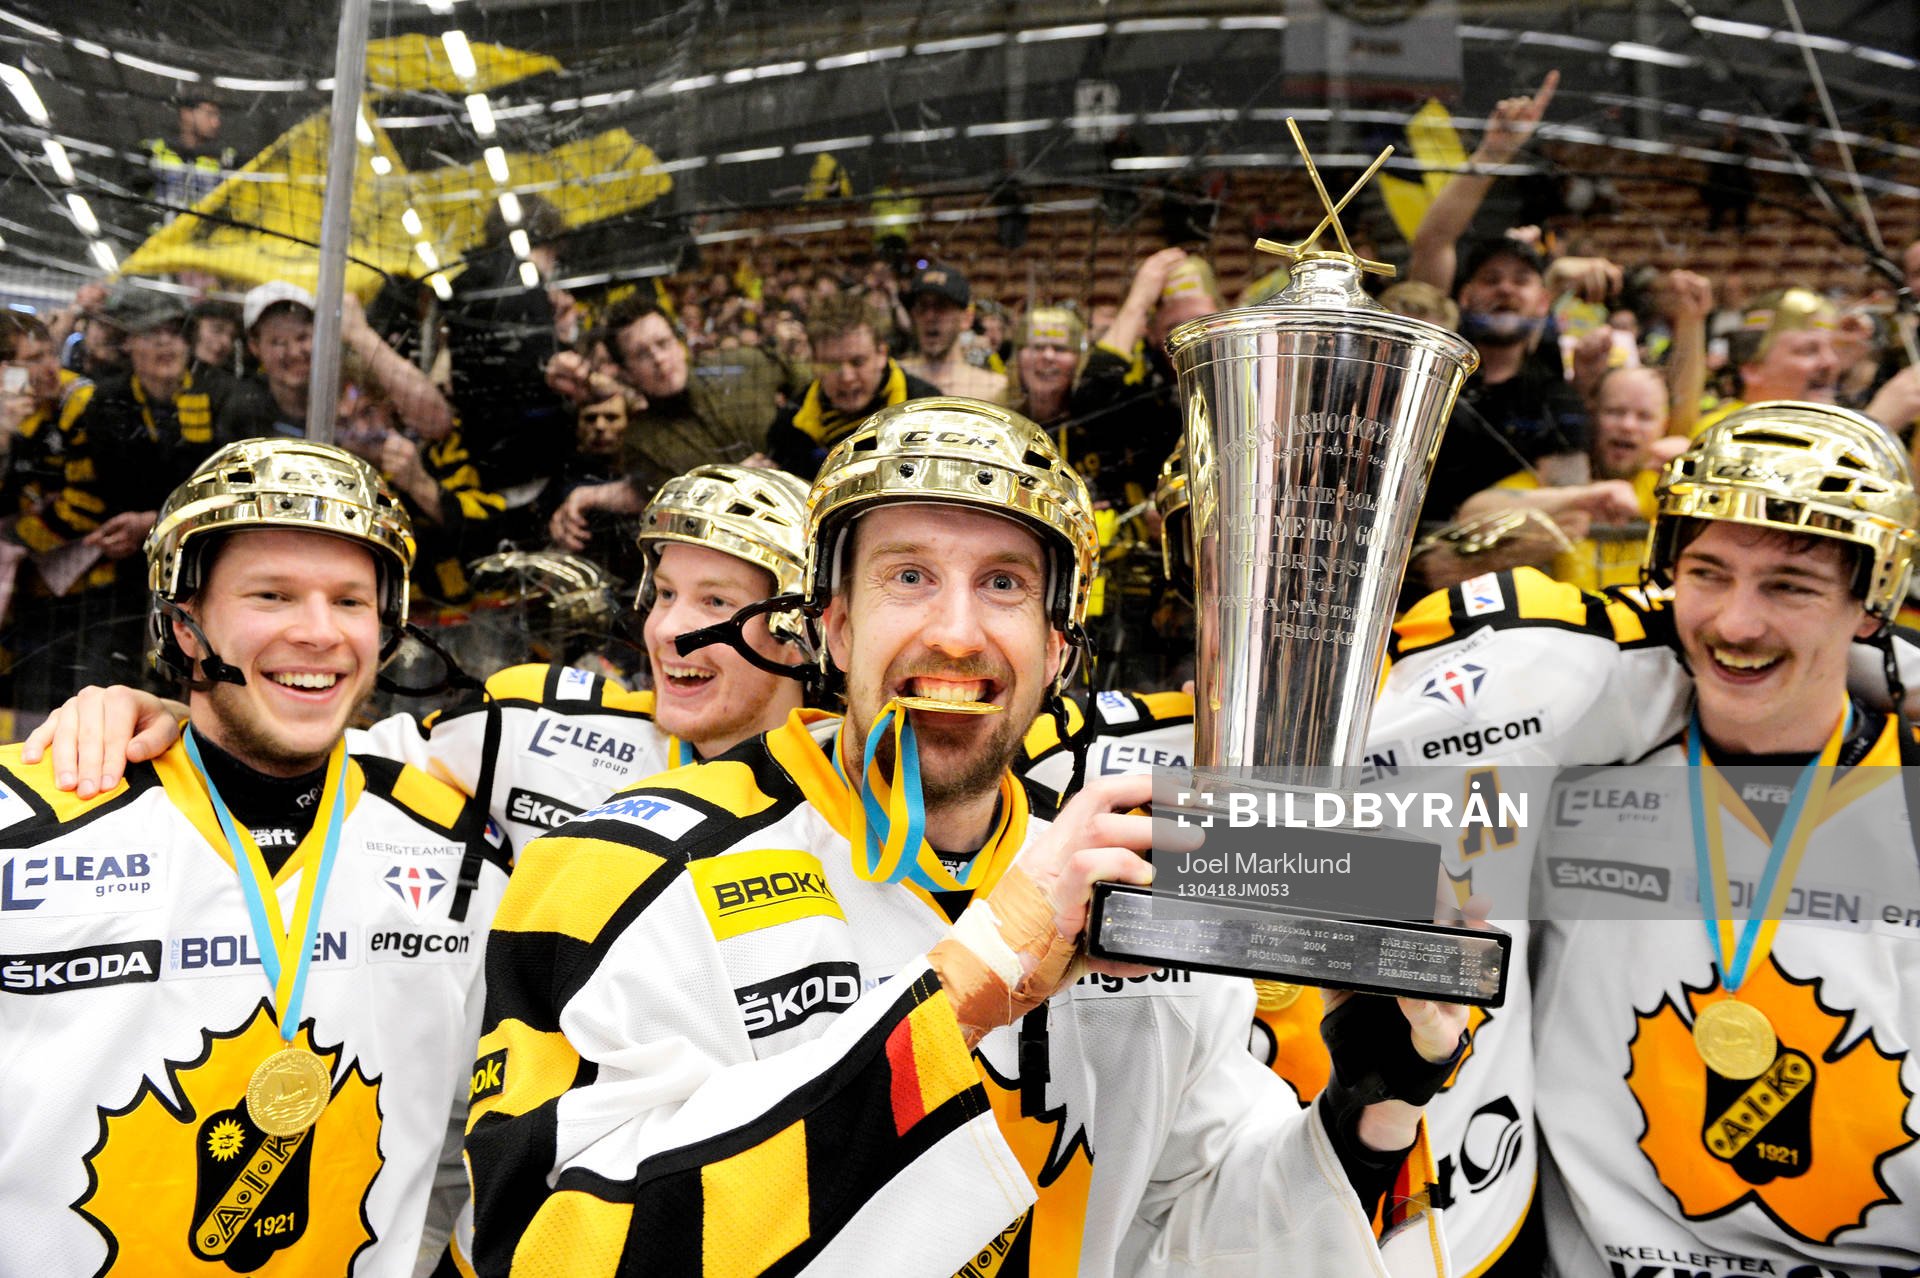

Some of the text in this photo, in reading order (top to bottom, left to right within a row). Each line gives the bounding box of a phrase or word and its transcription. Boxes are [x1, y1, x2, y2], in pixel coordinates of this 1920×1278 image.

[904, 430, 998, 449] CCM
[1272, 514, 1348, 544] METRO
[569, 727, 636, 763] LEAB
[1422, 716, 1542, 759] engcon
[591, 757, 629, 775] group
[1138, 747, 1189, 770] LEA
[511, 794, 571, 829] ŠKO
[1592, 789, 1662, 810] LEAB
[251, 828, 297, 847] aft
[366, 840, 466, 857] BERGTEAMET
[54, 853, 151, 881] LEAB
[1555, 861, 1664, 896] ŠKODA
[95, 881, 151, 897] group
[180, 930, 347, 970] BOLEN
[370, 931, 470, 959] engcon
[1250, 933, 1328, 953] HV 71 2004
[2, 951, 153, 989] ŠKODA
[1300, 956, 1316, 966] HC
[1327, 960, 1353, 970] 2005
[1378, 957, 1397, 967] HV
[1407, 951, 1451, 965] HOCKEY
[738, 975, 859, 1032] ŠKOD
[1755, 1141, 1799, 1166] 1921
[253, 1212, 296, 1239] 1921
